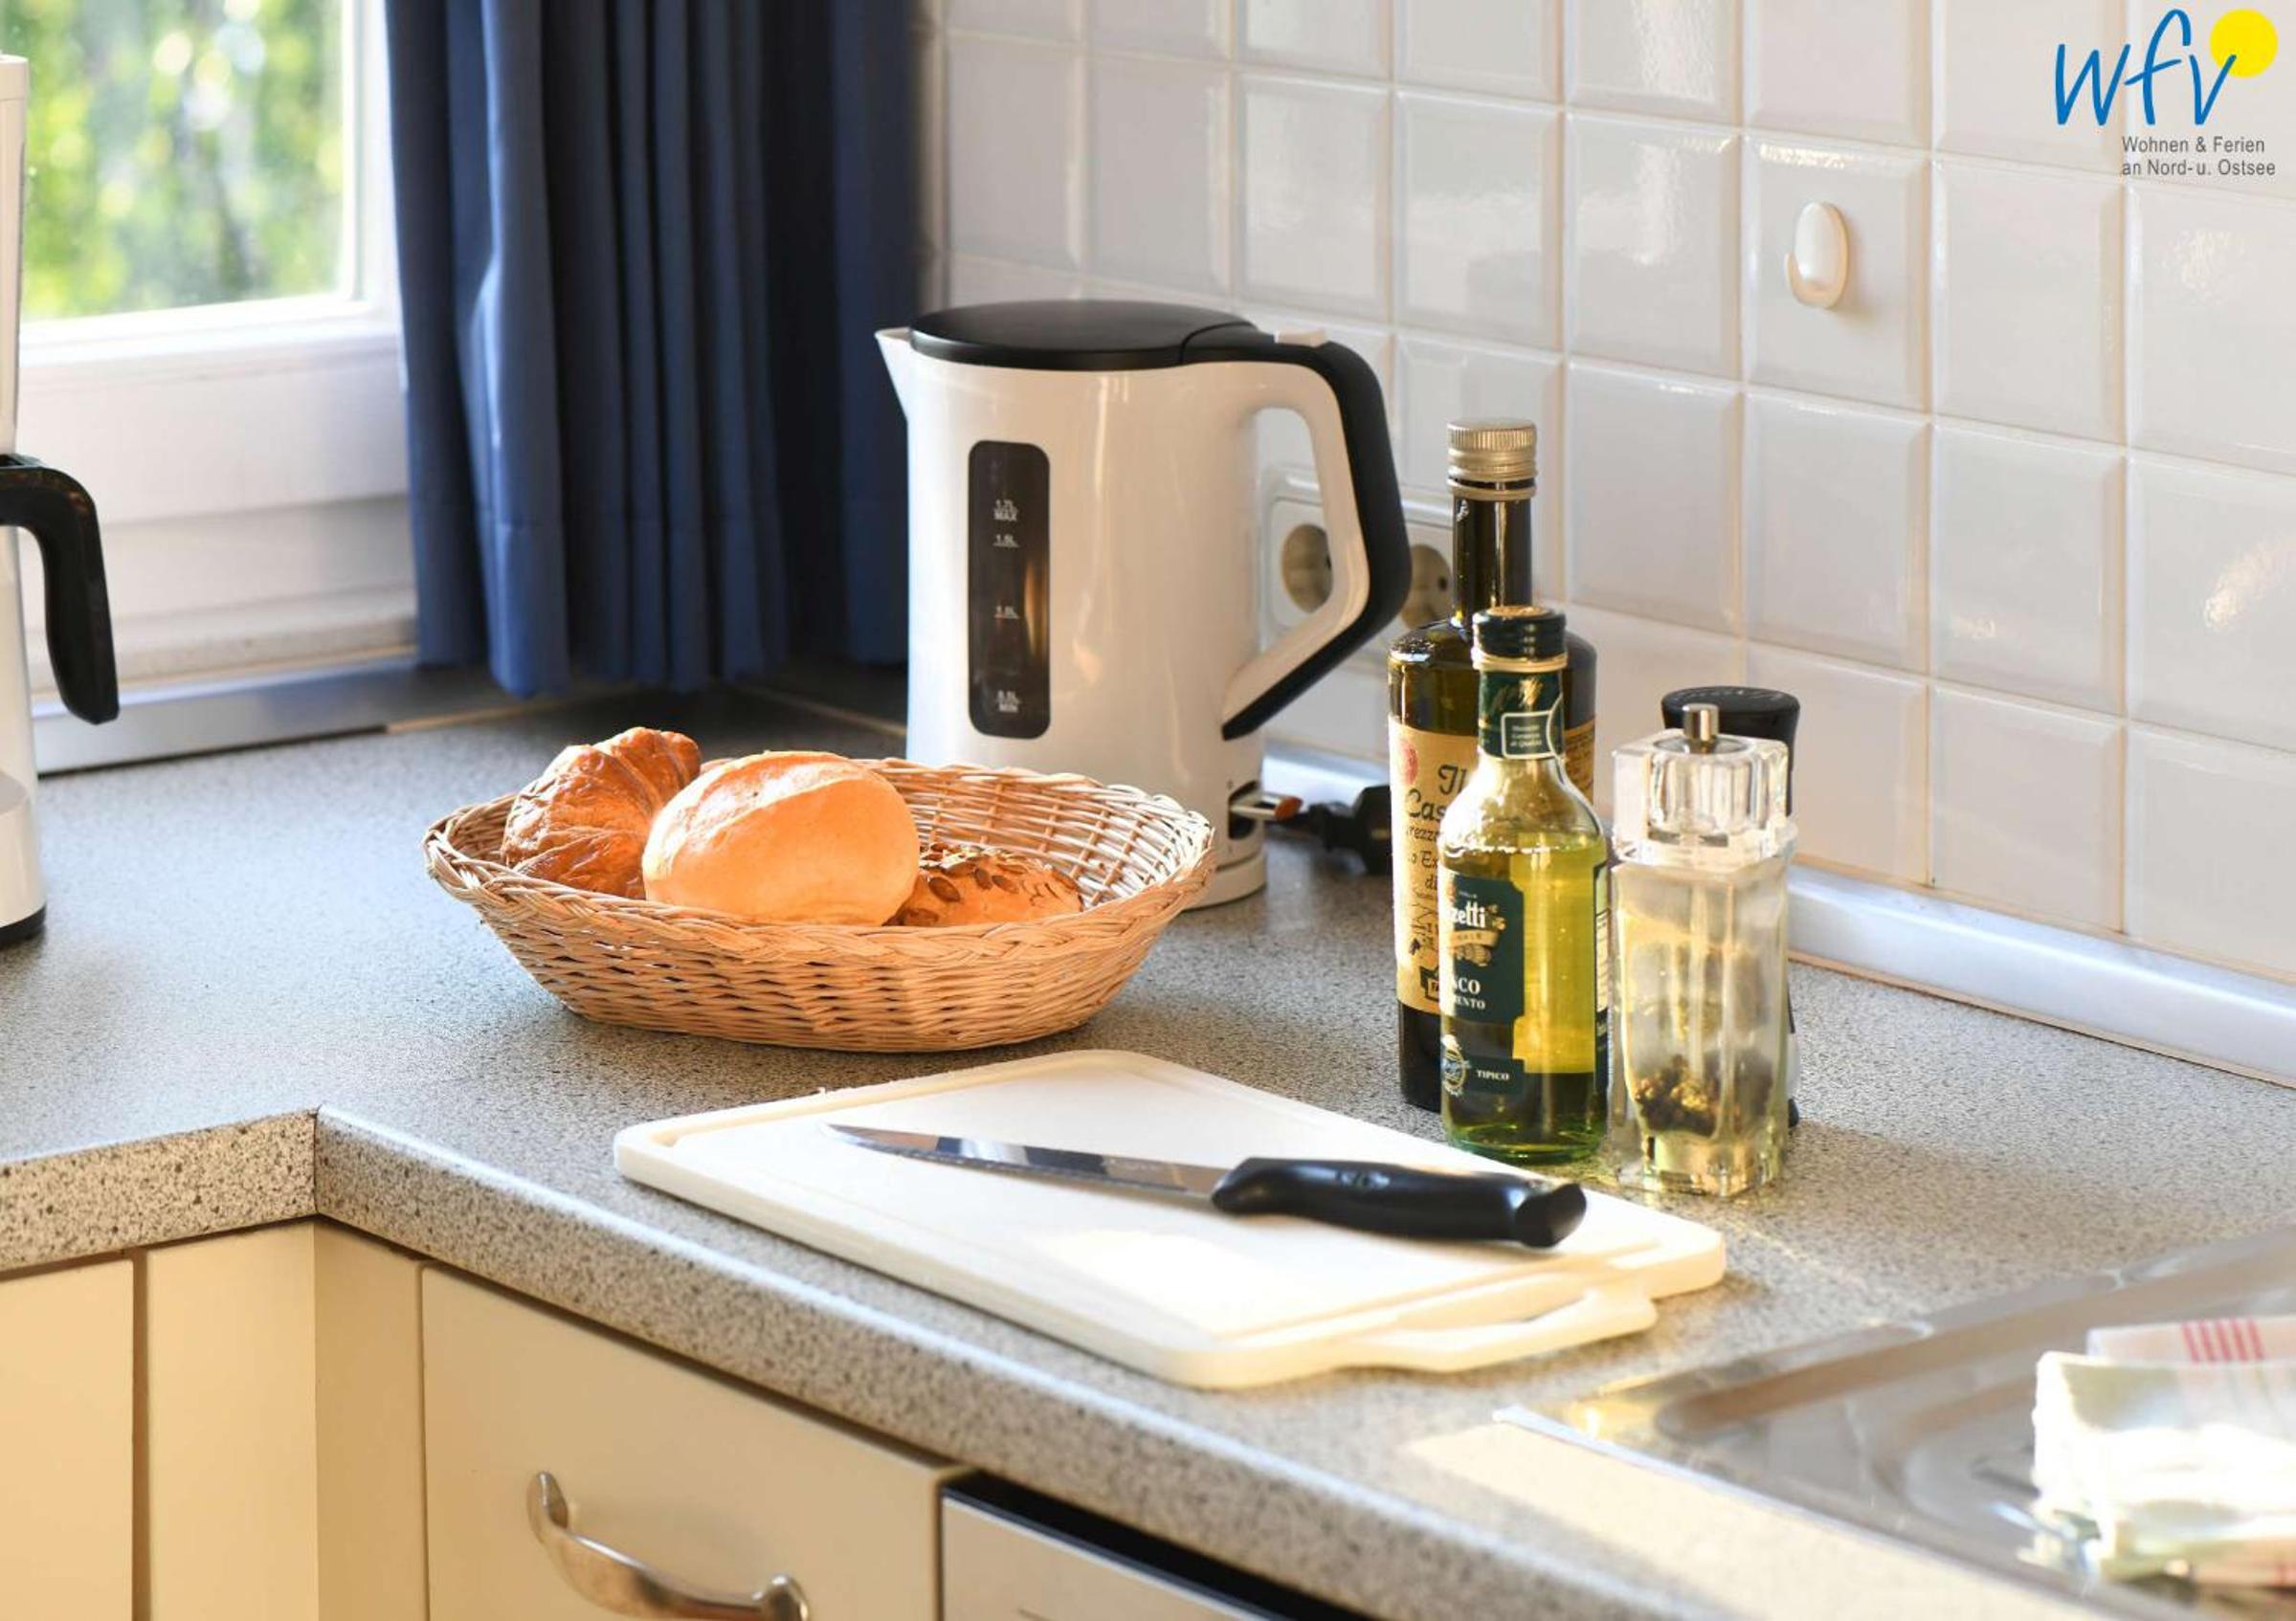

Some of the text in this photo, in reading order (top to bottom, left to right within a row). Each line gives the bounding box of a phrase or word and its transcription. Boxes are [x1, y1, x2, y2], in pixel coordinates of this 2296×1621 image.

[994, 510, 1017, 522] MAX
[1406, 788, 1447, 822] Cas
[1476, 1069, 1510, 1081] TIPICO
